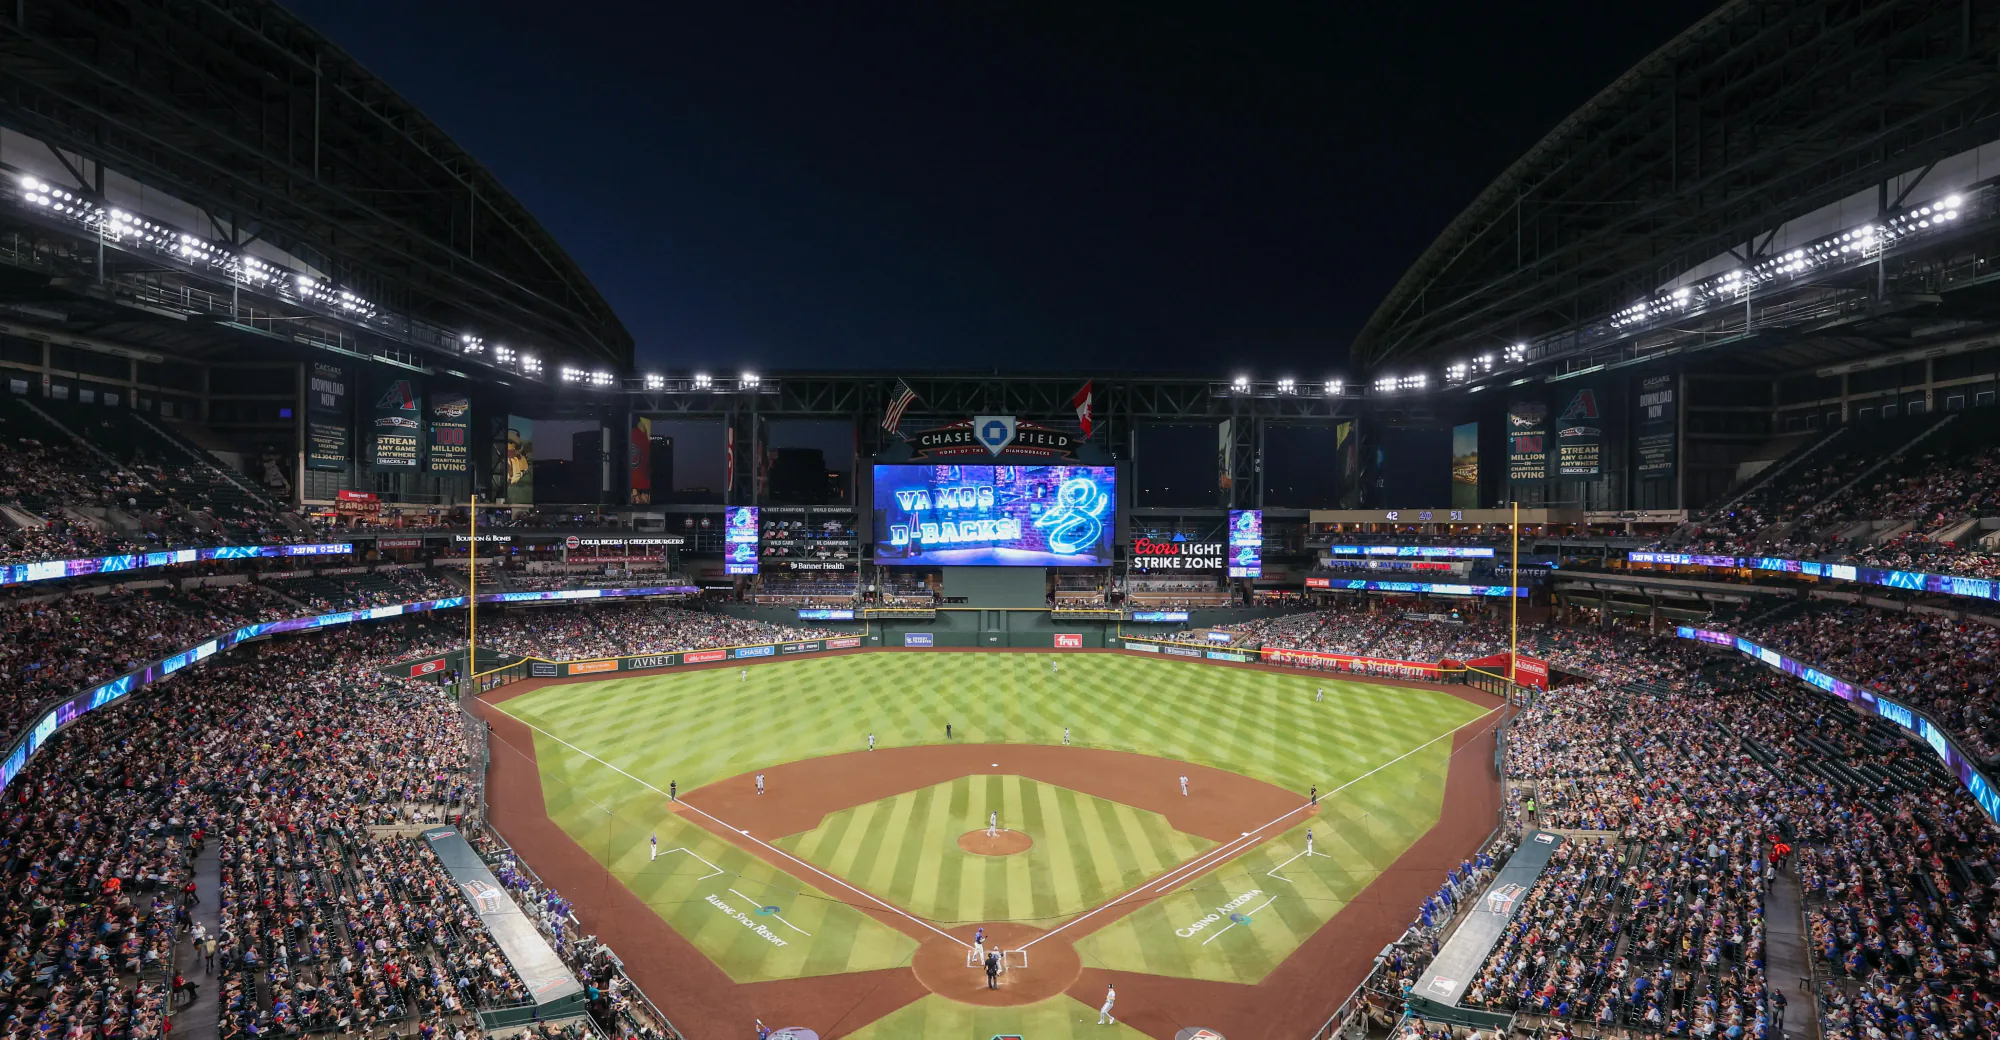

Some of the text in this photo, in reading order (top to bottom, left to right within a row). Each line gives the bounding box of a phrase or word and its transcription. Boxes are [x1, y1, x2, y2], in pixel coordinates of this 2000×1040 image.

[311, 377, 344, 396] DOWNLOAD
[321, 393, 335, 407] NOW
[1640, 390, 1672, 407] DOWNLOAD
[1648, 405, 1663, 418] NOW
[377, 437, 417, 446] STREAM
[921, 432, 1068, 446] CHASE FIELD
[1005, 448, 1050, 457] DIAMONDBACKS
[1560, 446, 1599, 455] STREAM
[1511, 453, 1546, 461] MILLION
[431, 463, 467, 471] GIVING
[1511, 471, 1545, 479] GIVING
[896, 485, 995, 511] VAMOS
[339, 501, 380, 511] SANDLOT
[1386, 511, 1398, 520] 42
[1419, 511, 1433, 520] 20
[1450, 510, 1463, 520] 51
[890, 518, 1022, 546] D-BACKS!
[1134, 538, 1222, 555] Coors LIGHT
[1134, 557, 1222, 568] STRIKE ZONE
[1330, 560, 1369, 568] ESTRELLA
[1951, 577, 1991, 599] VAMOS
[318, 611, 353, 626] VAMOS
[1057, 635, 1079, 647] fry's
[633, 656, 670, 667] AVNET
[1877, 697, 1912, 730] VAMOS
[1175, 889, 1264, 938] CASINO ARIZONA
[704, 893, 788, 947] TALKING STICK RESORT
